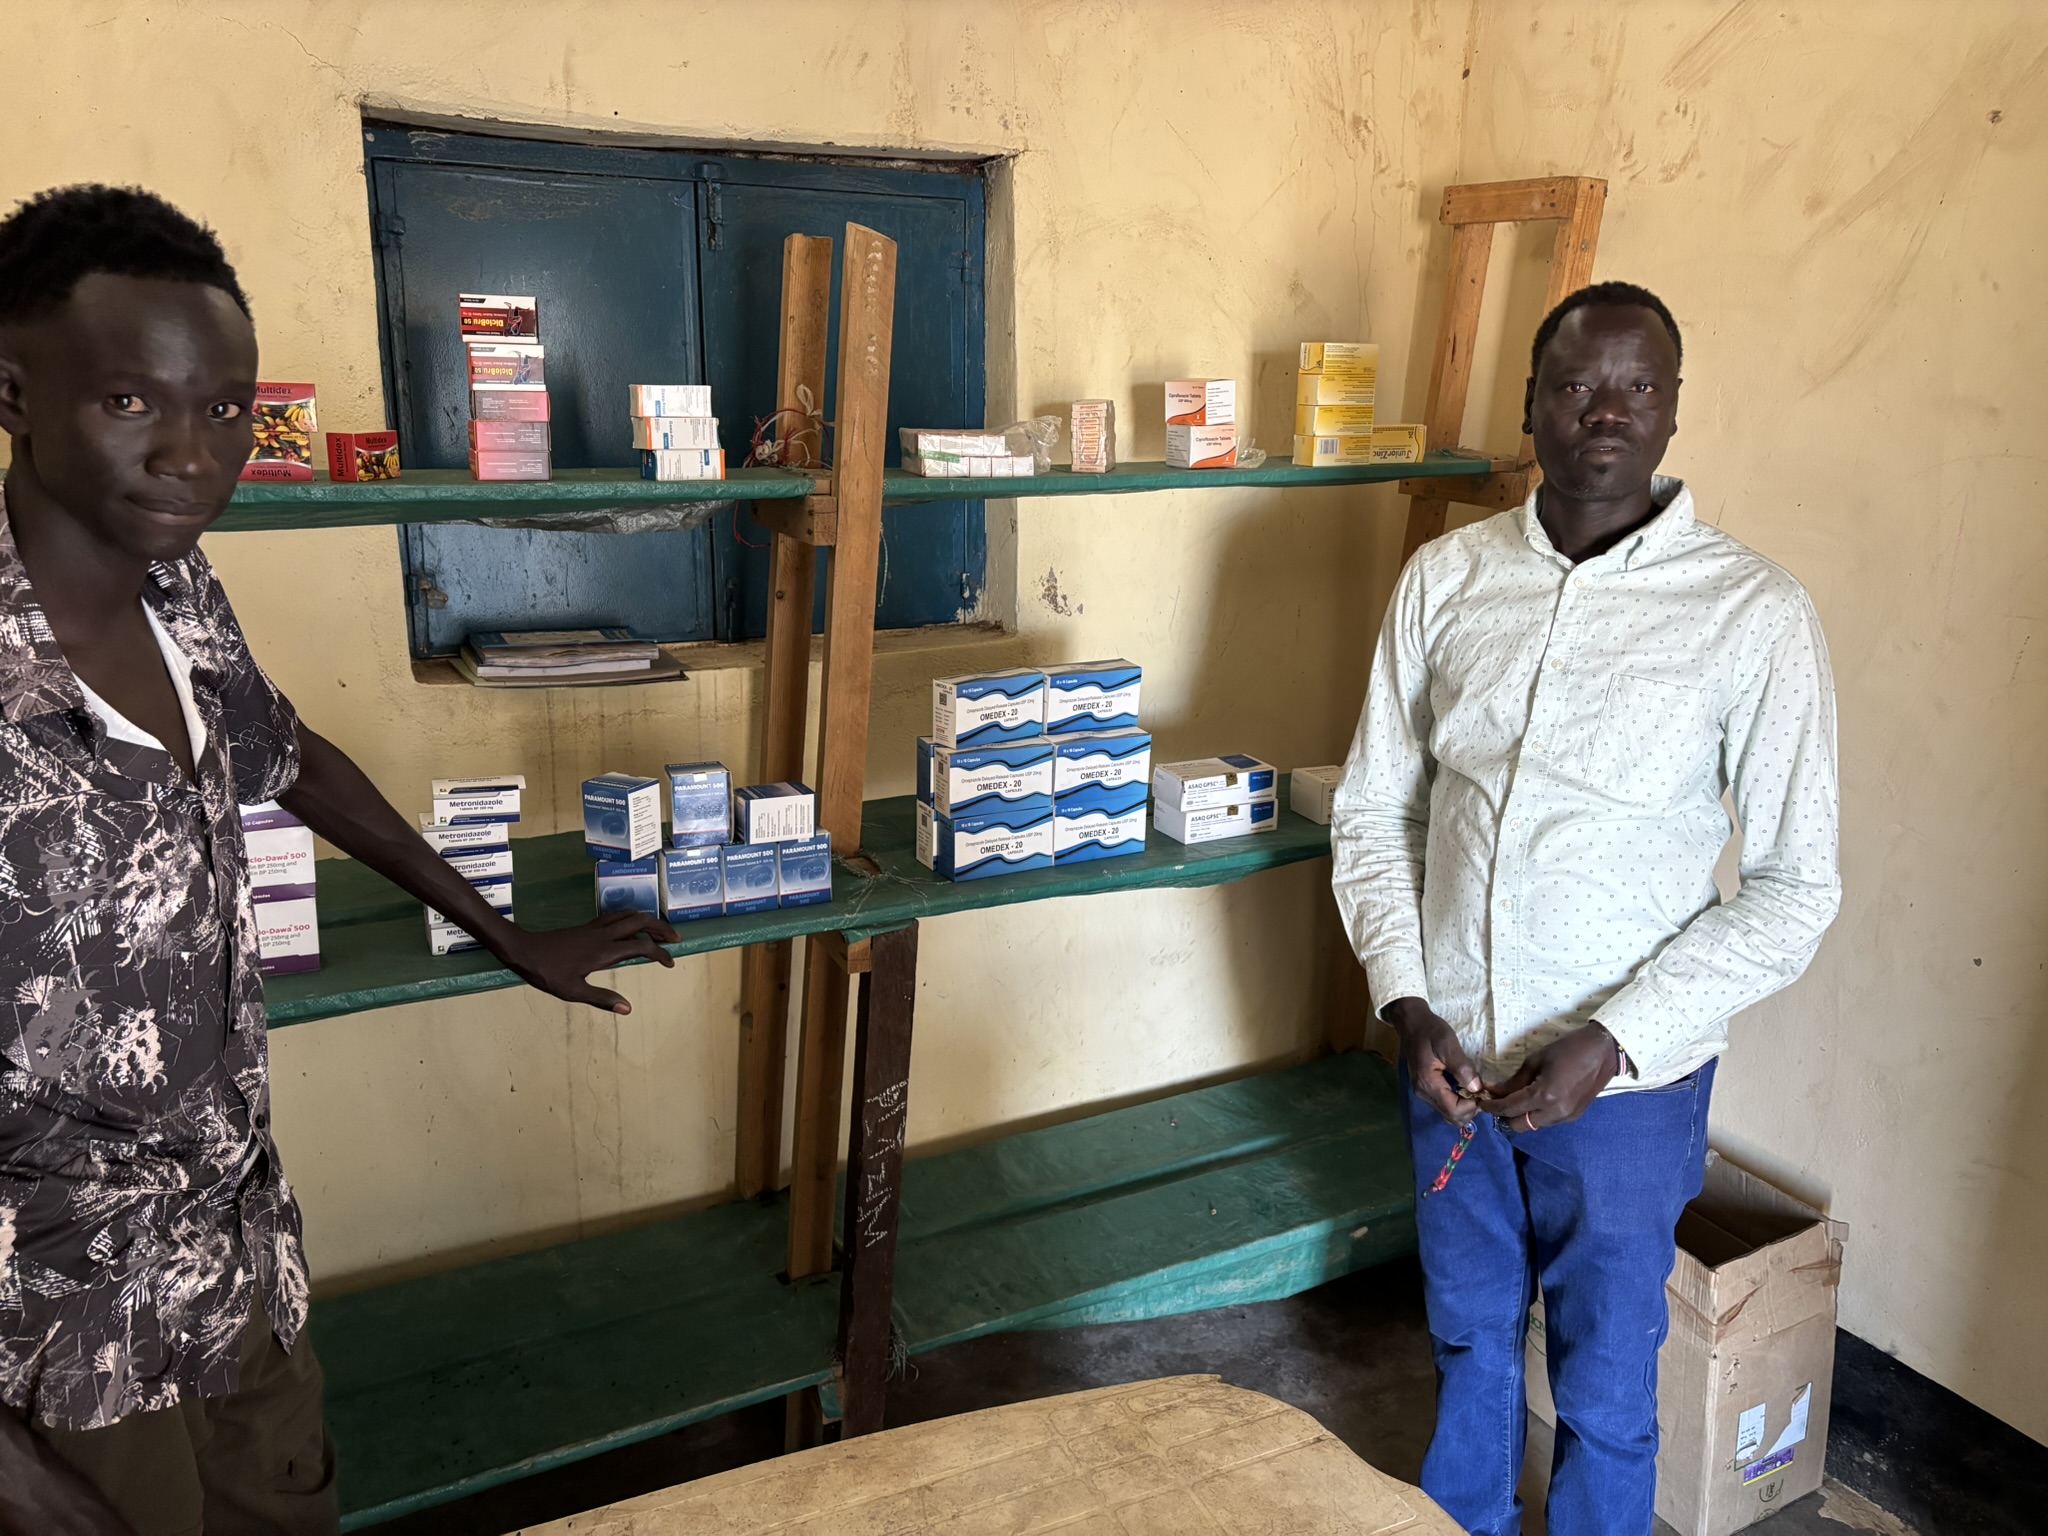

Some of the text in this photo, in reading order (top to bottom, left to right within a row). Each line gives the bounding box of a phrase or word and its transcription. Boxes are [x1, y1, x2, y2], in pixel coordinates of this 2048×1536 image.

[336, 438, 345, 476] Multidex
[1073, 702, 1100, 711] OMEDEX
[980, 710, 1006, 721] OMEDEX
[1080, 770, 1109, 780] OMEDEX
[977, 781, 1008, 791] OMEDEX
[450, 799, 503, 807] Metronidazole
[584, 794, 614, 804] PARAMOUNT
[439, 830, 491, 839] Metronidazole
[1079, 829, 1106, 839] OMEDEX
[782, 845, 815, 854] PARAMOUNT
[980, 843, 1010, 854] OMEDEX
[727, 851, 761, 861] PARAMOUNT
[454, 861, 496, 870] tronidazole
[669, 858, 705, 868] PARAMOUNT
[789, 892, 820, 900] PARAMOUNT
[734, 899, 766, 908] PARAMOUNT
